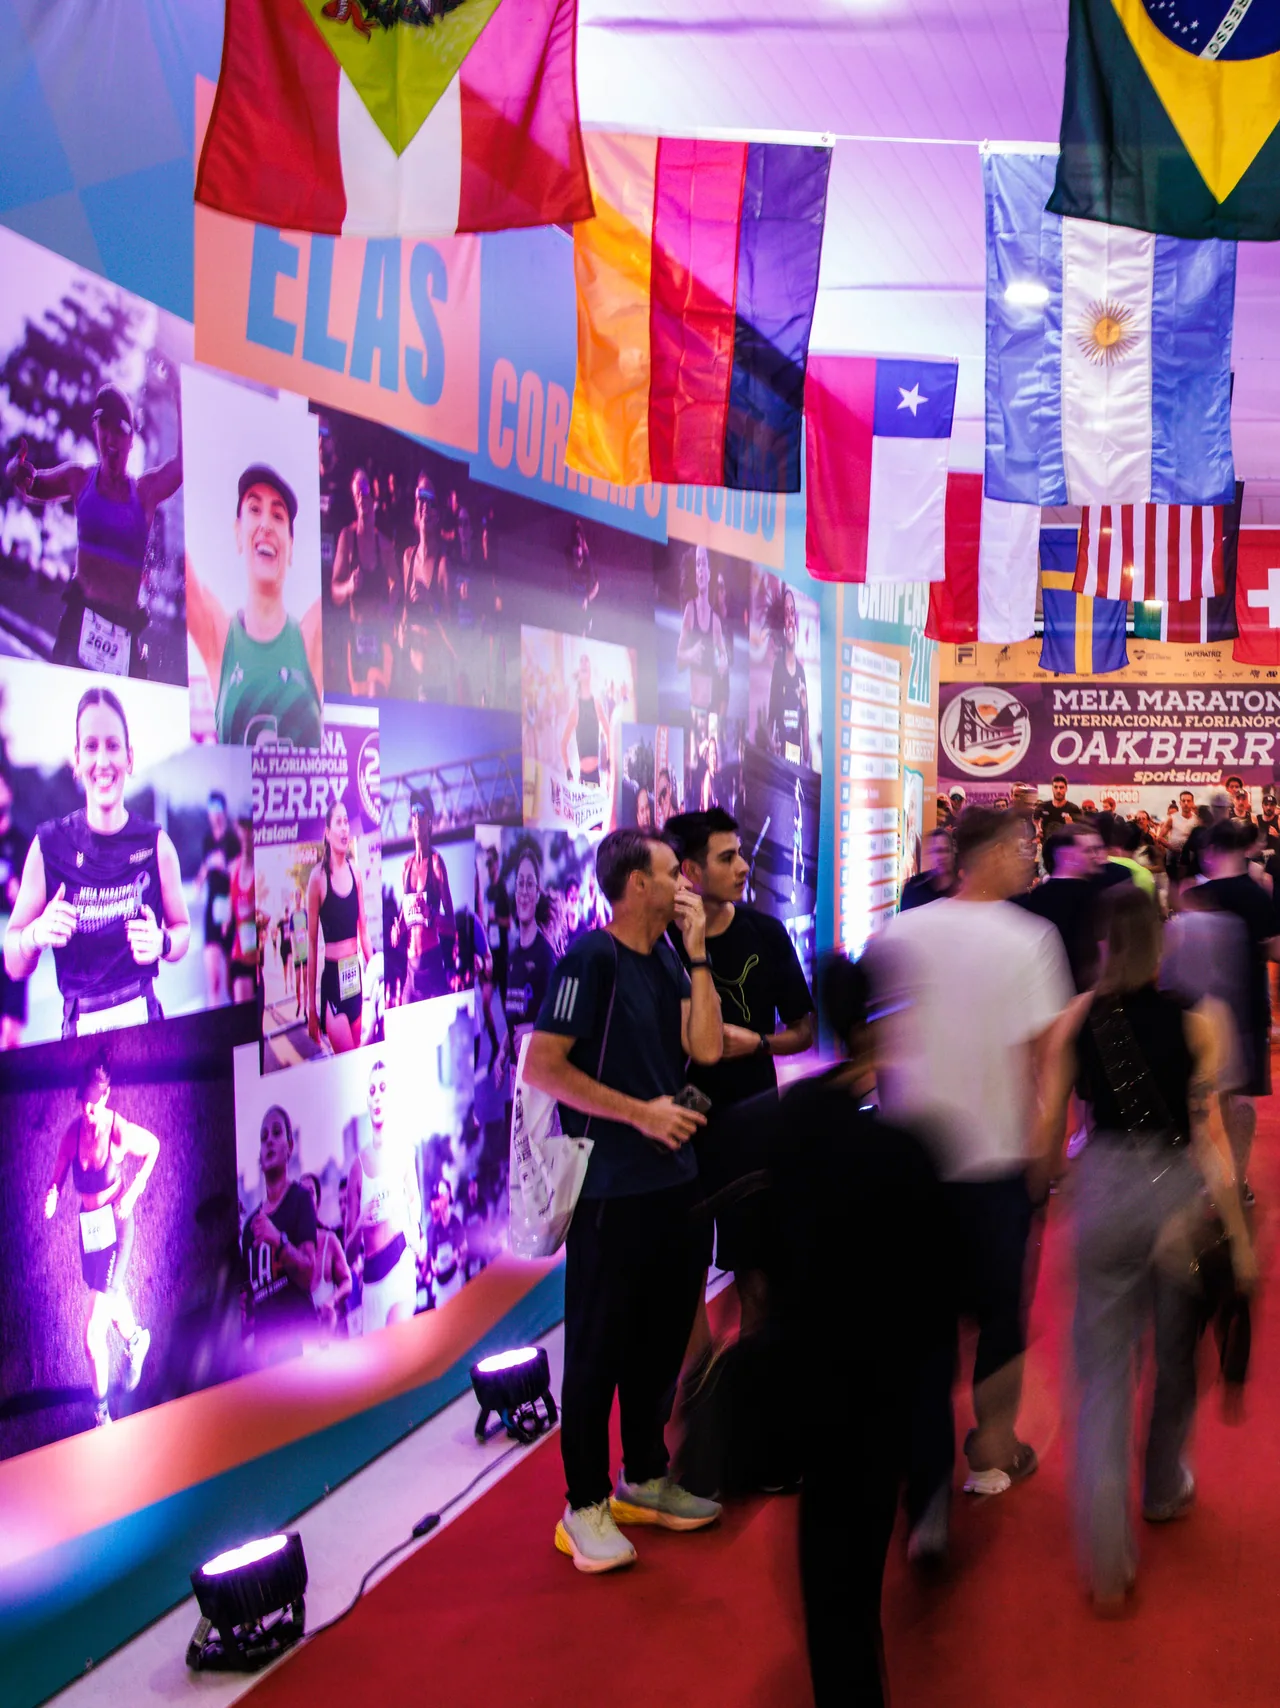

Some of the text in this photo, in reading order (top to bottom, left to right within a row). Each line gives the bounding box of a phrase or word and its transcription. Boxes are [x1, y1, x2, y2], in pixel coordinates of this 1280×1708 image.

[246, 222, 448, 407] ELAS
[1053, 690, 1131, 712] MEIA
[1053, 715, 1182, 728] INTERNACIONAL
[1133, 769, 1222, 784] sportsland
